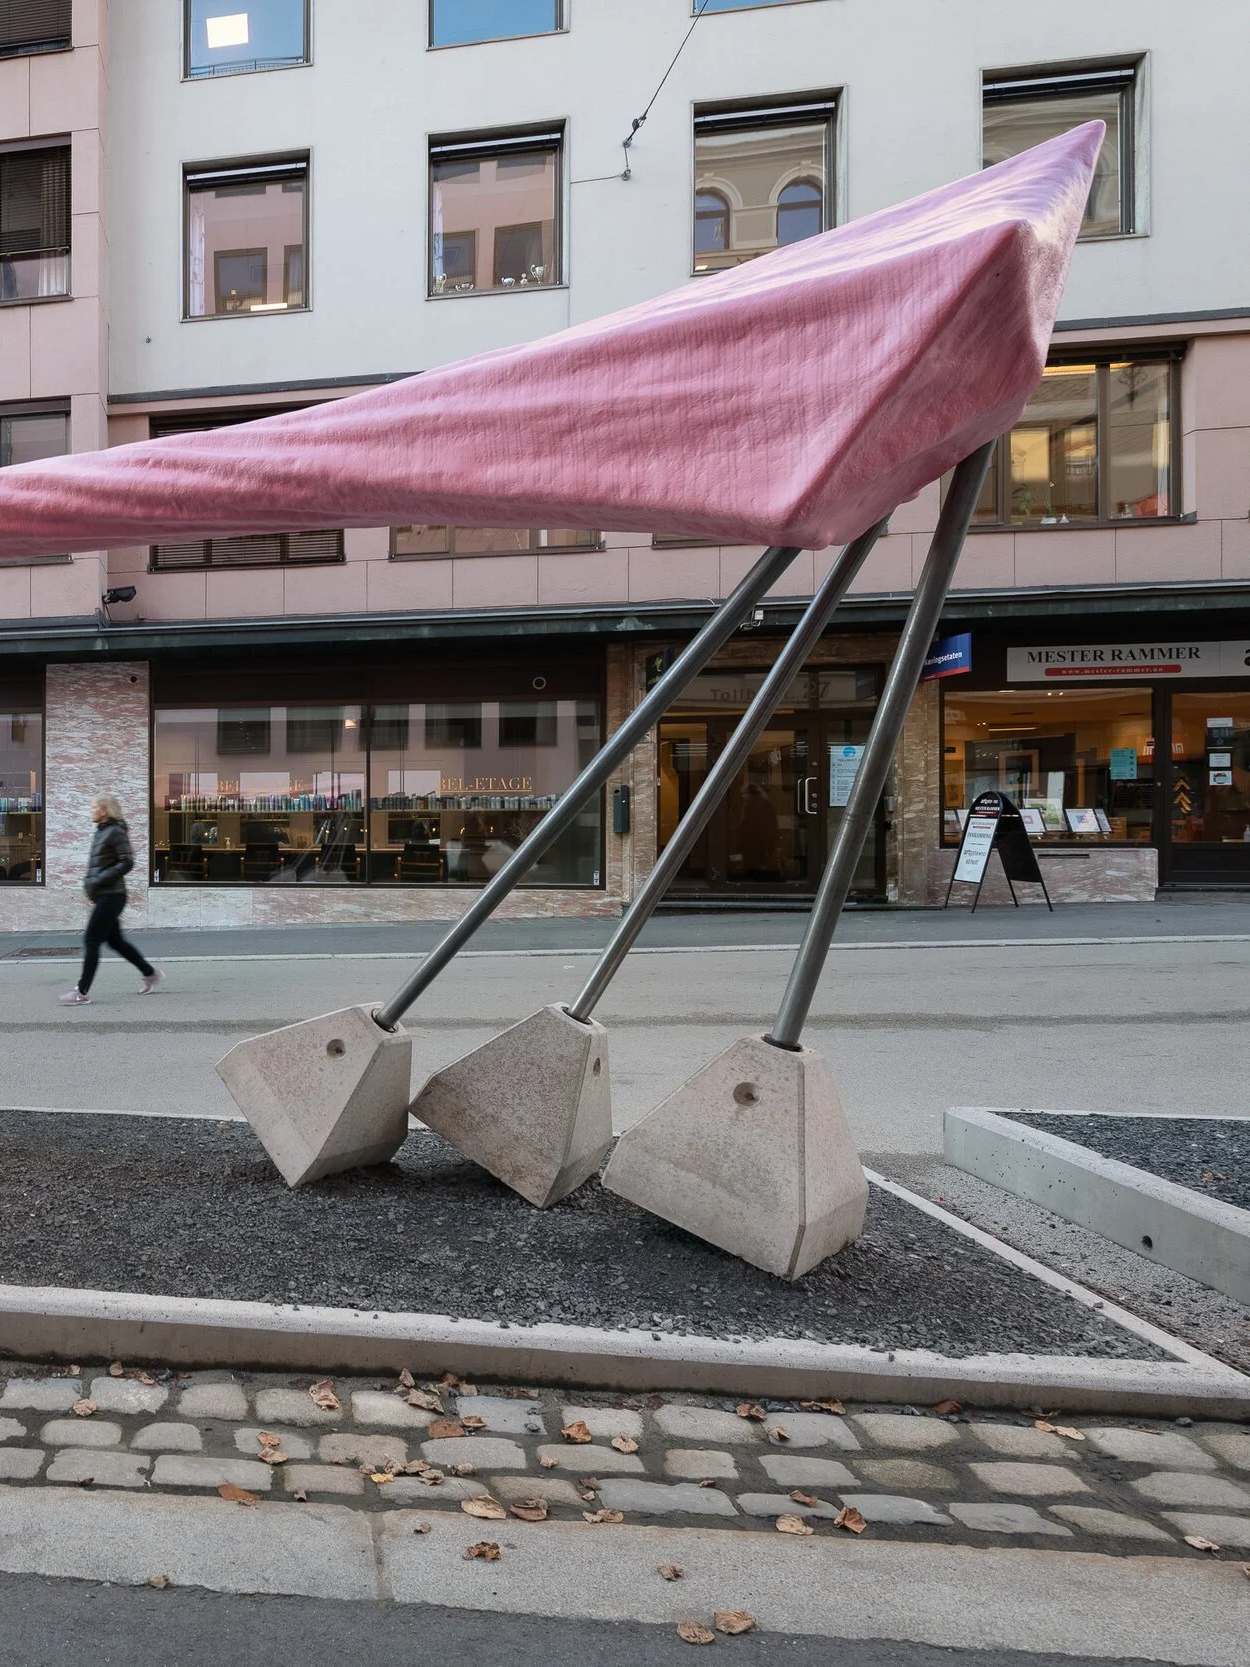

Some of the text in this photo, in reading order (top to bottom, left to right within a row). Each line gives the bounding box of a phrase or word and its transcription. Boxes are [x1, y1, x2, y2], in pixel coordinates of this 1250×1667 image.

[1027, 646, 1201, 664] MESTER RAMMER
[803, 681, 831, 700] 27
[440, 777, 533, 791] BEL-ETAGE
